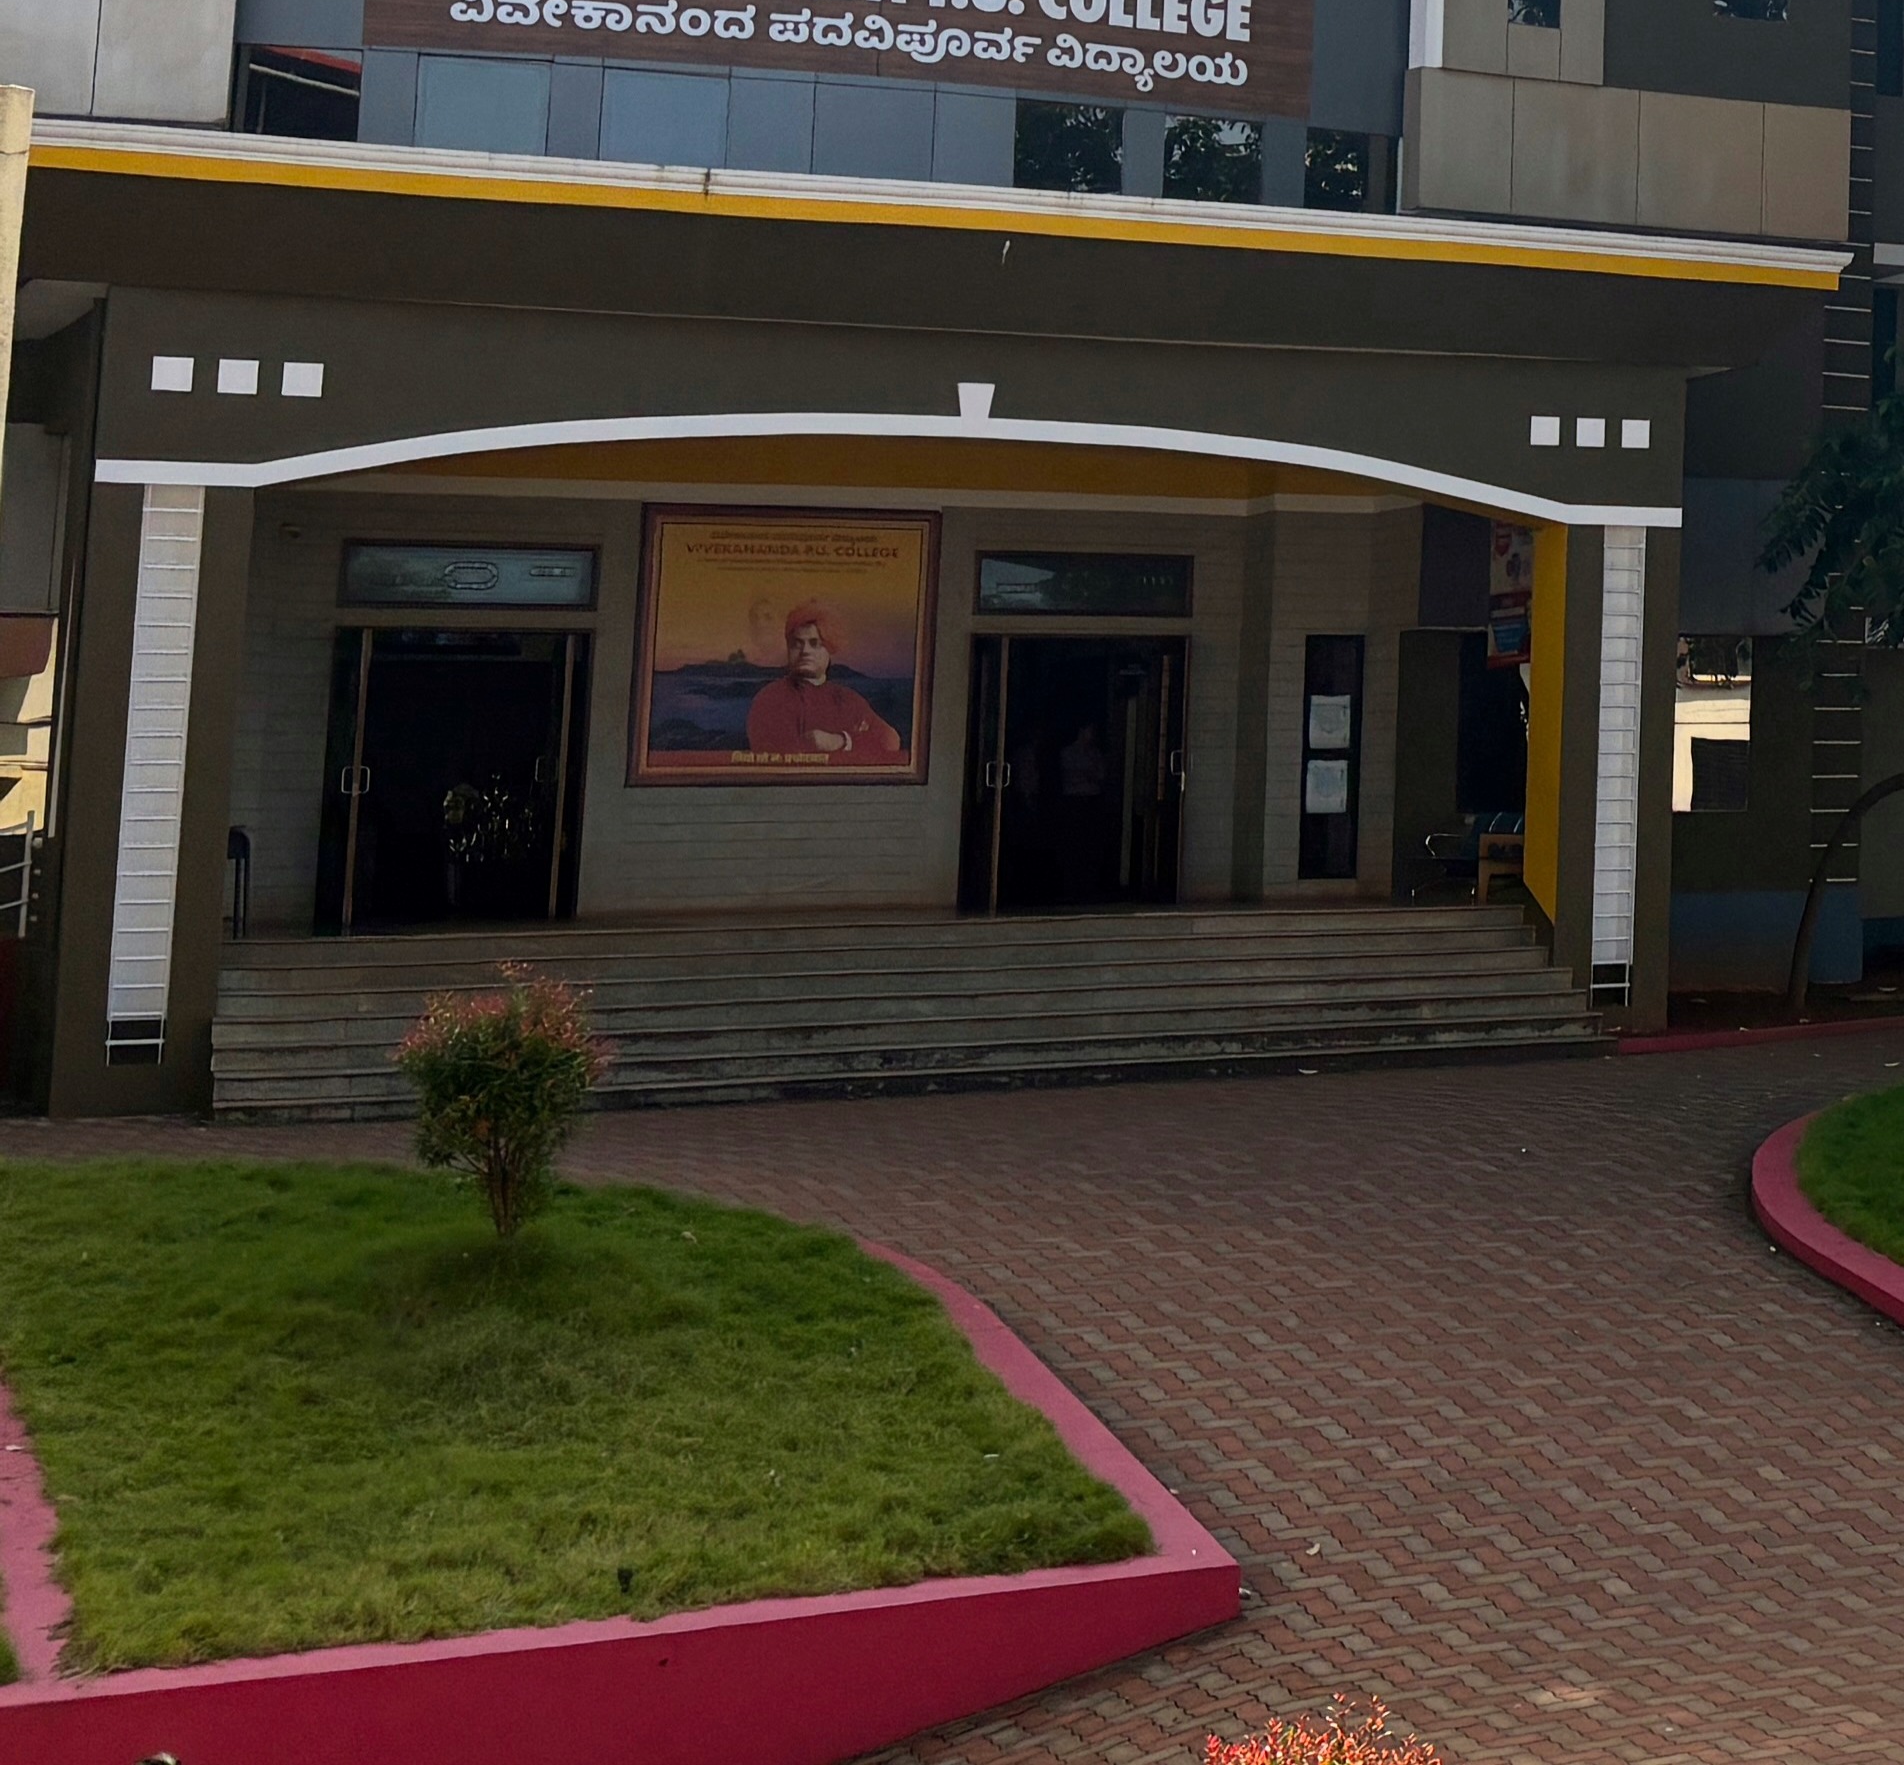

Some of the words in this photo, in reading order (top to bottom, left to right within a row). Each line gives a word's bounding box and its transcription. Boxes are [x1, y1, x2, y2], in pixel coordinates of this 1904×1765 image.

[768, 7, 1042, 63] ಪದವಿಪೂರ್ವ
[1047, 33, 1249, 93] ವಿದ್ಯಾಲಯ
[687, 543, 798, 556] VIVEKANANDA
[835, 545, 899, 558] COLLEGE
